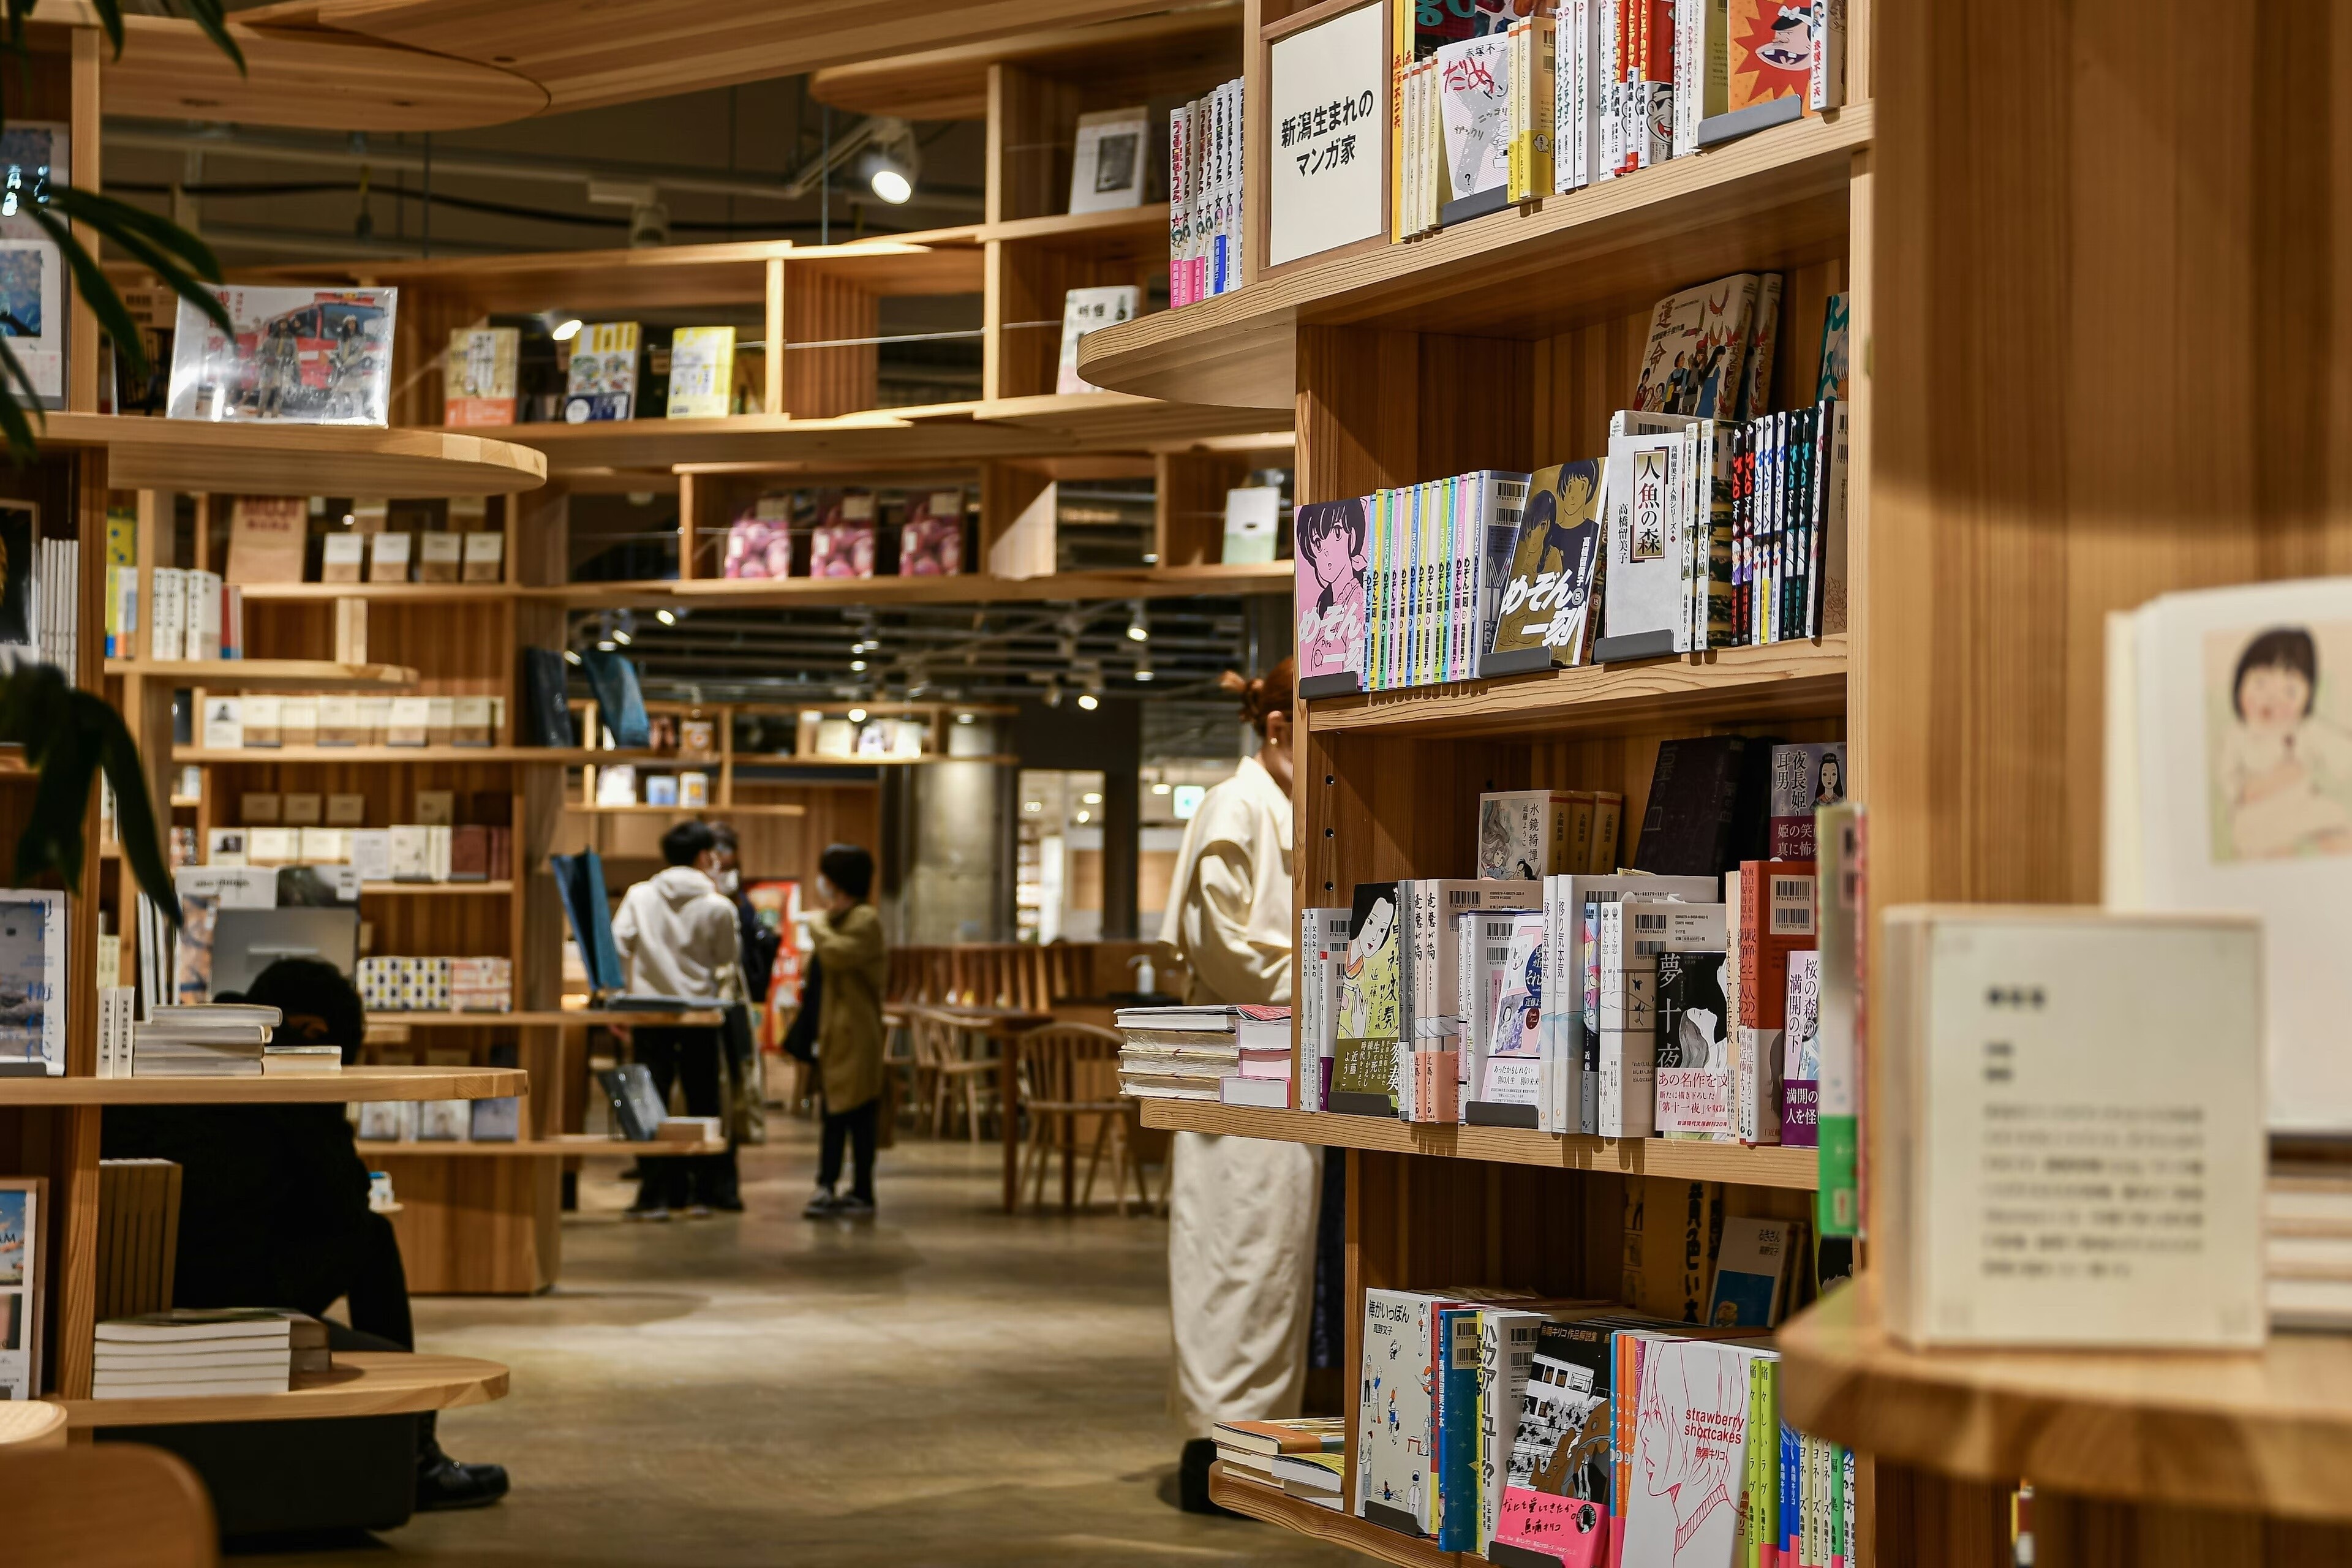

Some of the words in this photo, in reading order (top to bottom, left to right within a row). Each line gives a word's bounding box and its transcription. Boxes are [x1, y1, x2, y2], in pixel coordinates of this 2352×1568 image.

[1281, 89, 1374, 148] 新潟生まれの
[1296, 134, 1357, 177] マンガ家
[1638, 455, 1661, 554] 人魚の森
[1618, 503, 1628, 564] 高橋留美子
[1501, 569, 1573, 616] めぞん
[1298, 602, 1362, 643] めぞん
[1521, 606, 1588, 647] 一刻
[1776, 752, 1790, 791] 耳男
[1528, 803, 1540, 862] 水鏡綺譚
[1746, 927, 1756, 1029] 戦争と一人の女
[1803, 959, 1818, 1037] 桜の森の
[1525, 997, 1541, 1007] 近藤よ
[1657, 952, 1684, 1068] 夢十夜
[1788, 974, 1802, 1054] 満開の下
[1341, 1052, 1350, 1087] ようこ
[1349, 1050, 1359, 1075] 近藤
[1659, 1072, 1728, 1088] あの名作を文
[1659, 1090, 1715, 1100] 新たに描き下ろした
[1659, 1101, 1726, 1115] 「第十一夜」を収録
[1786, 1088, 1819, 1105] 満開の
[1368, 1299, 1410, 1324] 棒がいっぽん
[1373, 1323, 1393, 1336] 高野文子
[1684, 1422, 1741, 1444] shortcakes
[1685, 1408, 1744, 1432] strawberry
[1800, 1433, 1808, 1512] マヨネーズ
